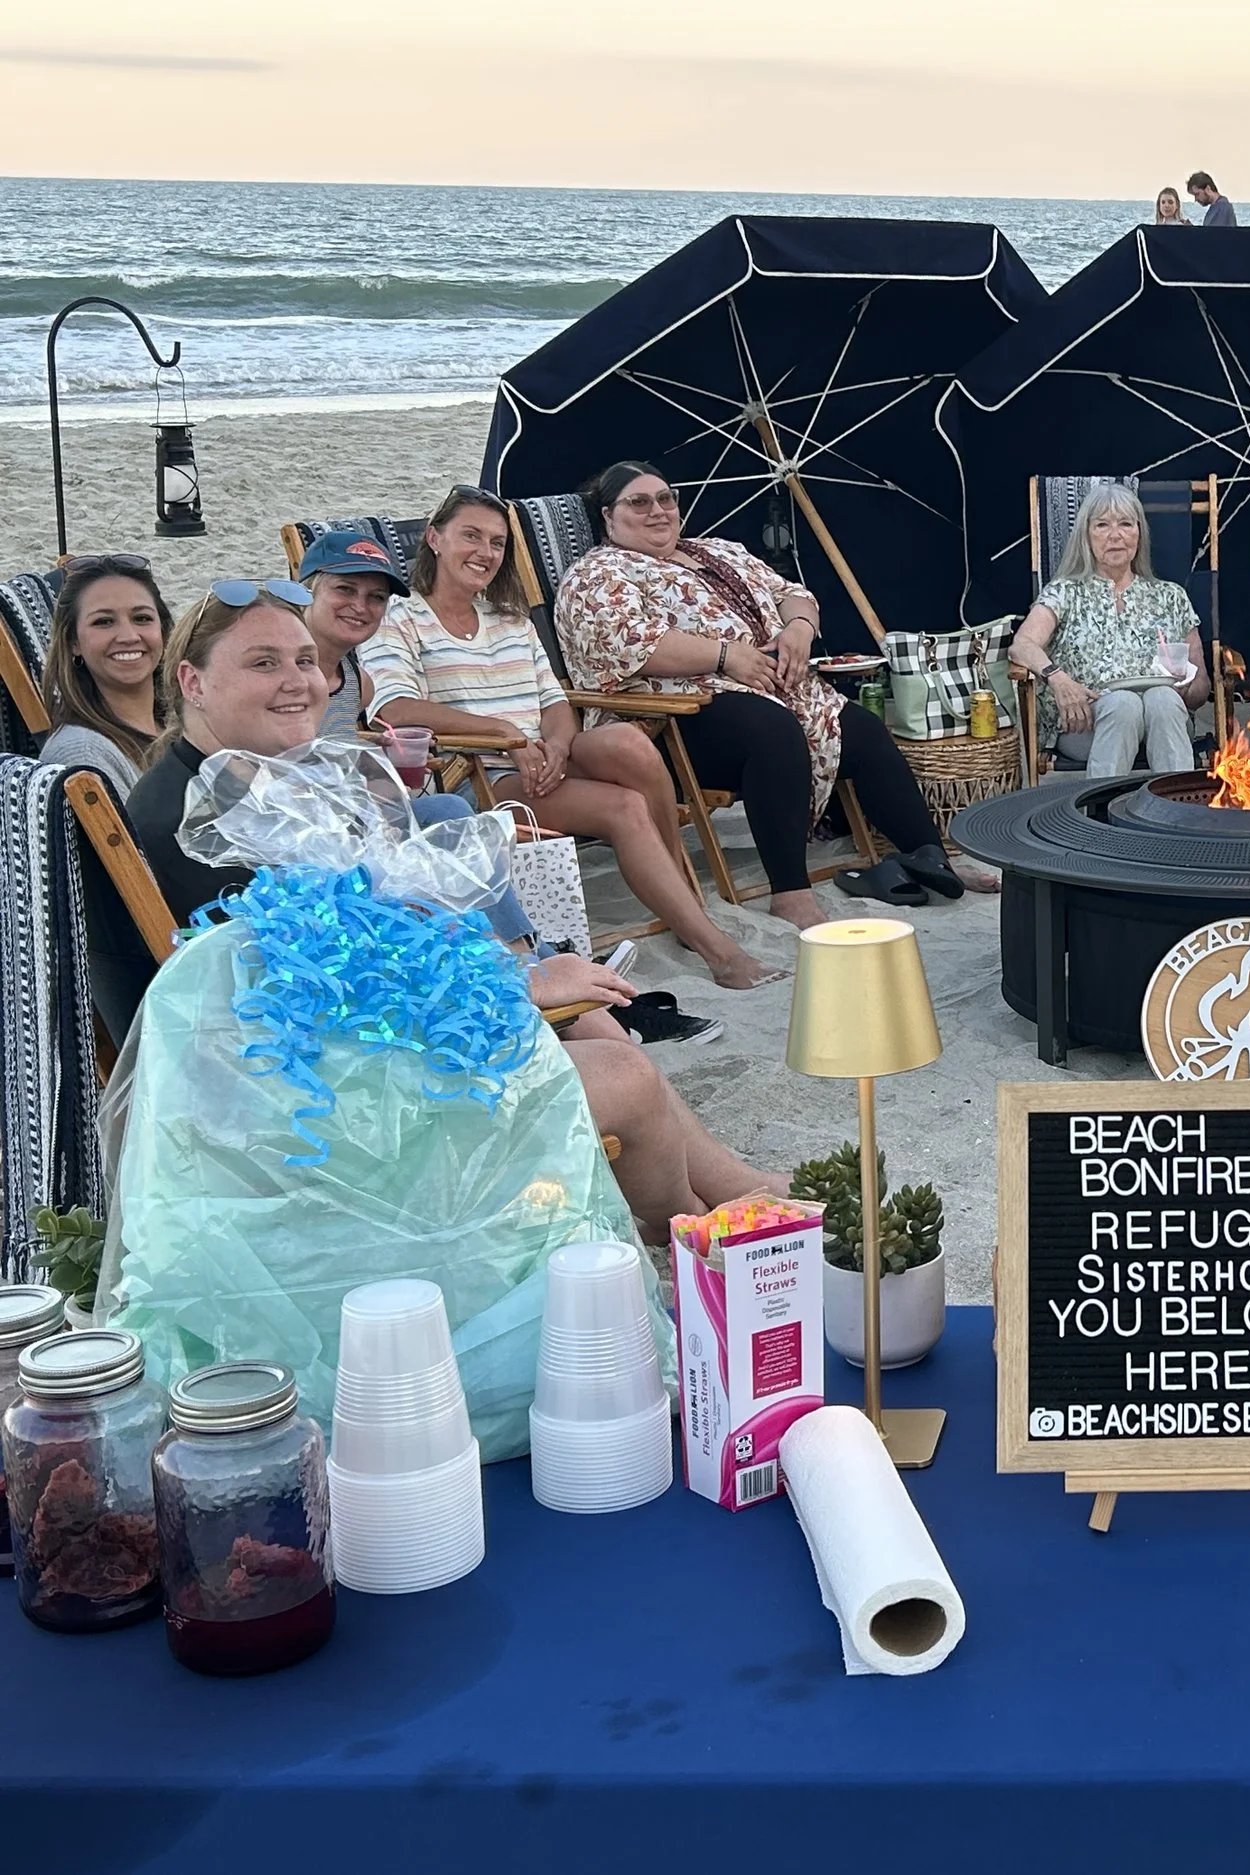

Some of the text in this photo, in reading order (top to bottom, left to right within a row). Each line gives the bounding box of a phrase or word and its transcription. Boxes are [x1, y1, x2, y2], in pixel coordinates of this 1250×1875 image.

[1069, 1114, 1207, 1155] BEACH
[745, 1240, 805, 1262] FOOD LION
[752, 1259, 799, 1280] Flexible
[755, 1277, 797, 1295] Straws
[1048, 1297, 1143, 1339] YOU
[689, 1368, 700, 1439] FOOD LION
[700, 1360, 711, 1457] Flexible Straws
